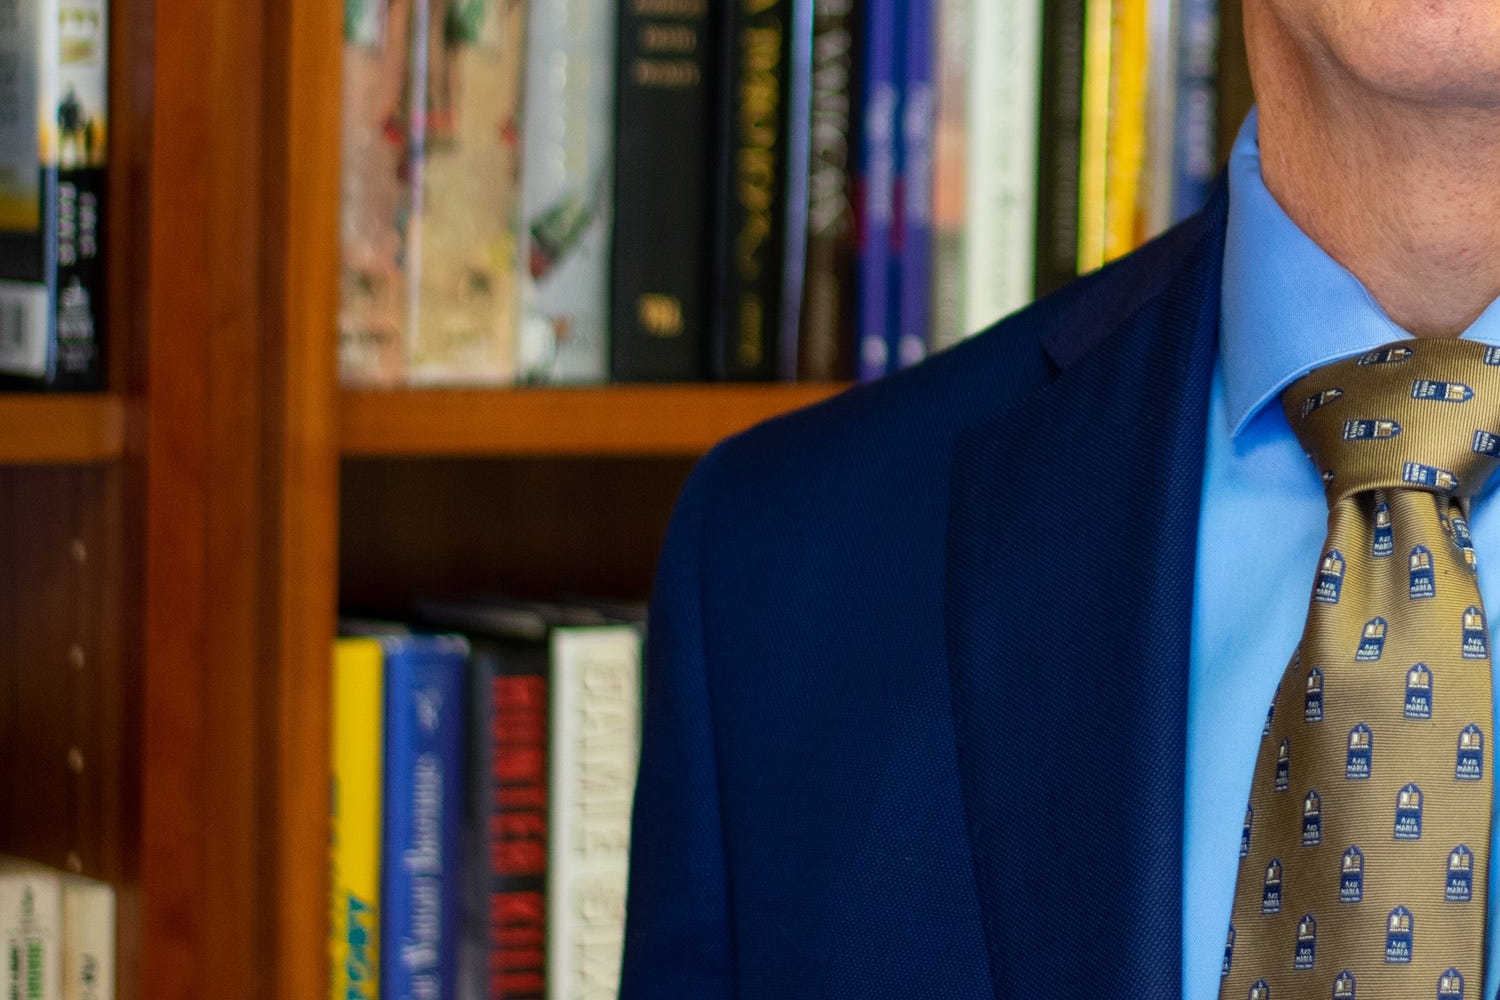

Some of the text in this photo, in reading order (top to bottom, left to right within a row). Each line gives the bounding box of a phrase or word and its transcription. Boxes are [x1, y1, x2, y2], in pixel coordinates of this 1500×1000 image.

[1406, 703, 1428, 712] MARIA
[1347, 764, 1368, 772] MARIA
[1457, 764, 1479, 773] MARIA
[491, 674, 546, 874] HUNTER
[1396, 824, 1418, 833] MARIA
[1447, 886, 1469, 894] MARIA
[1386, 948, 1409, 956] MARIA
